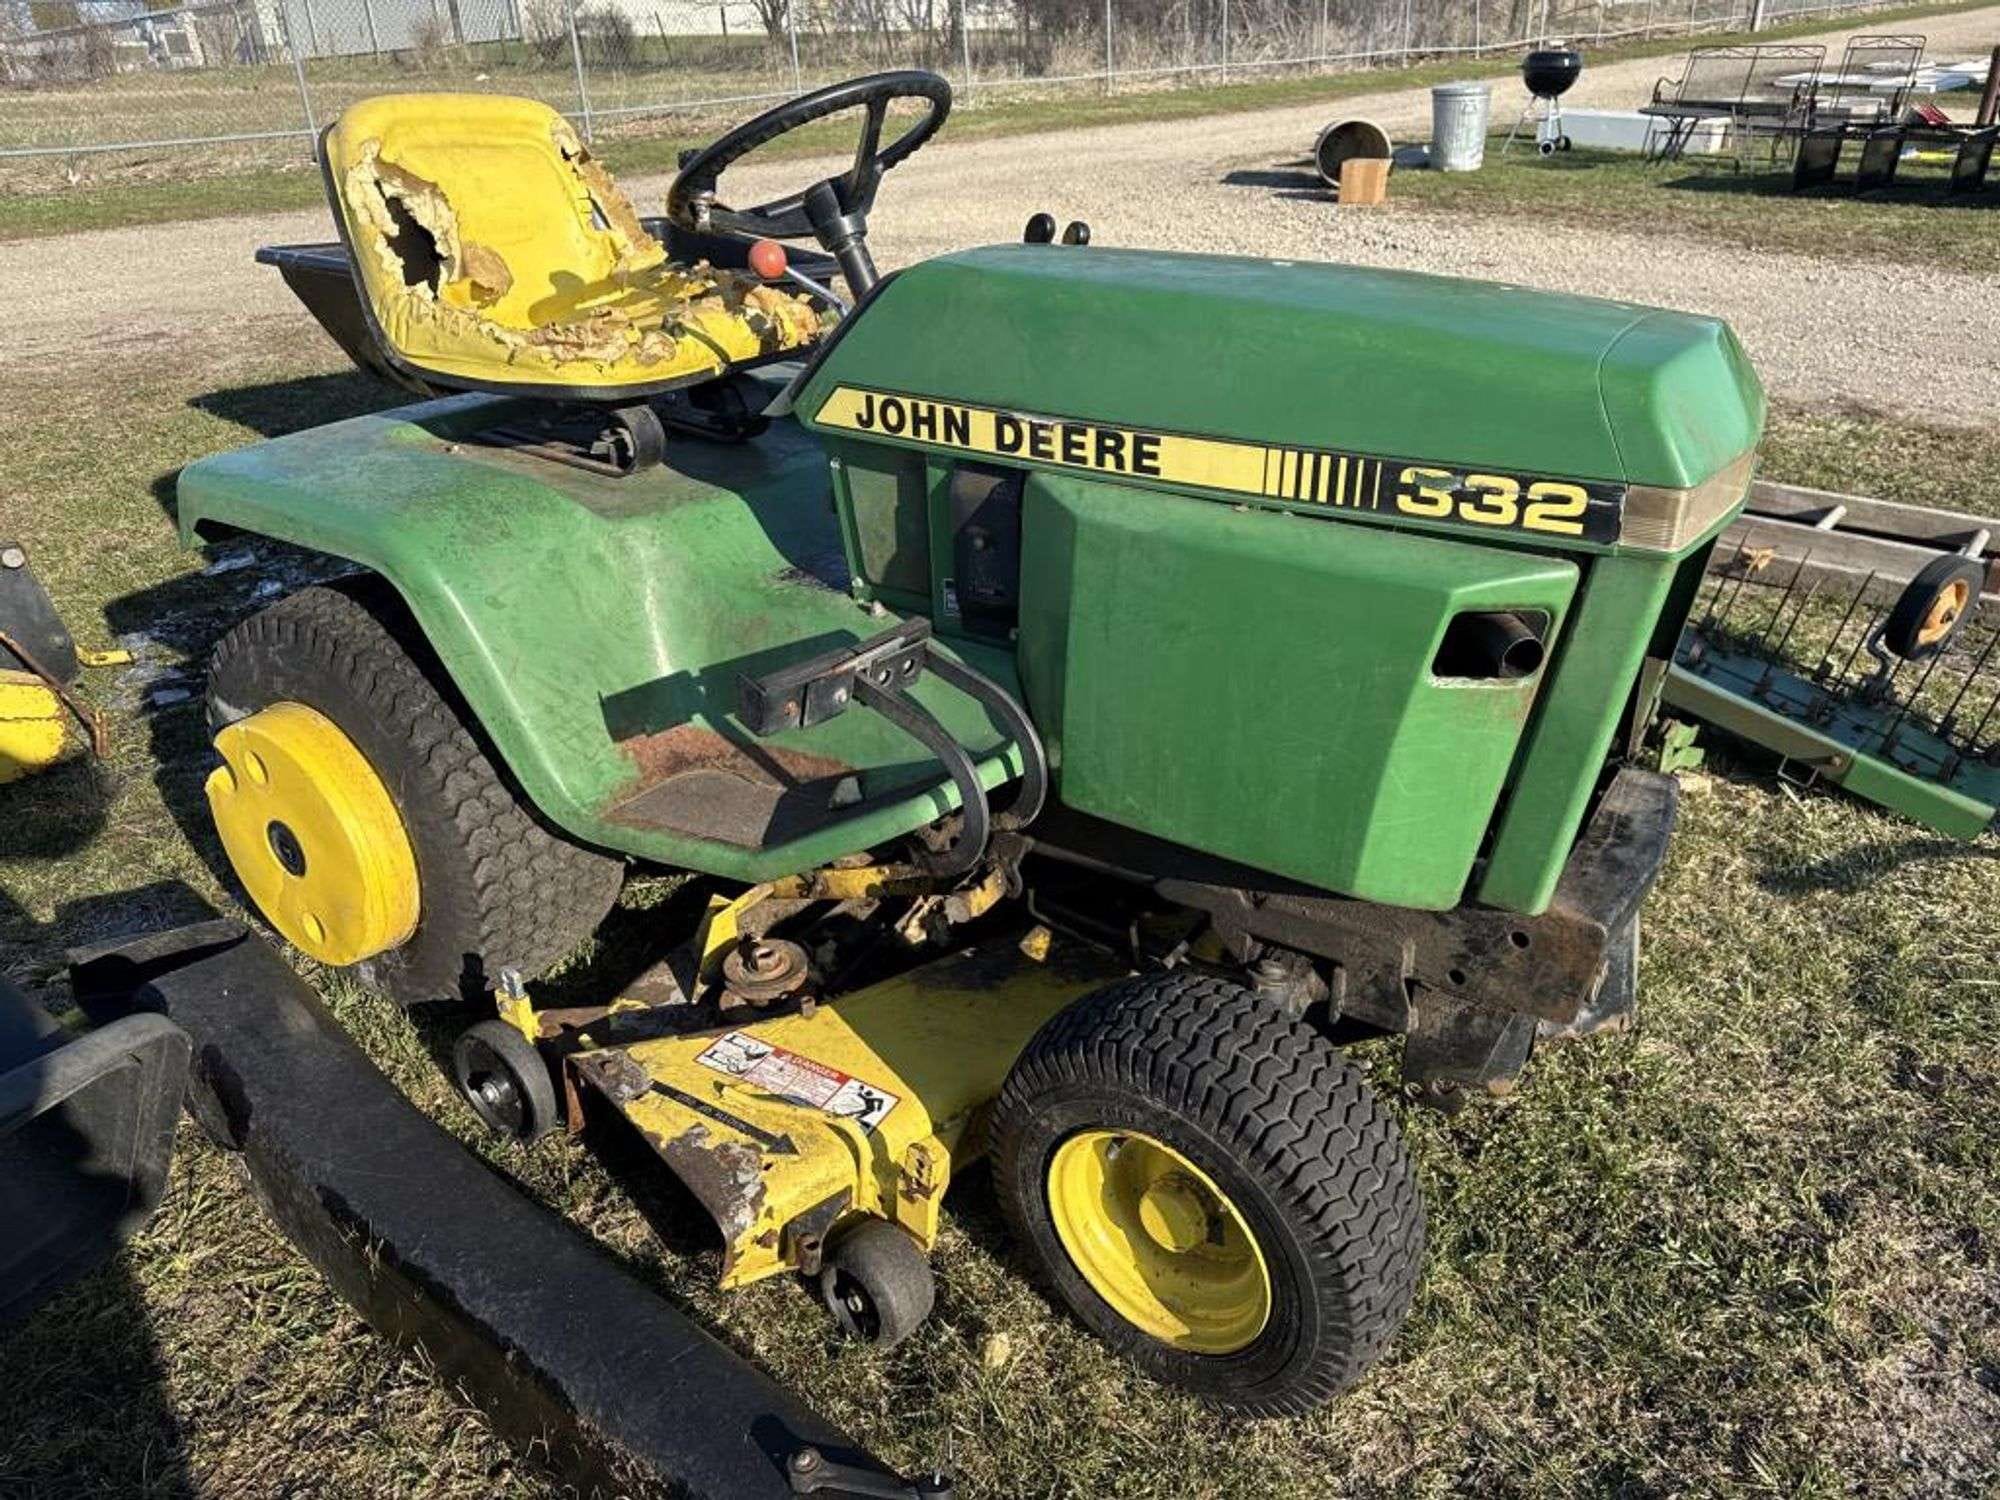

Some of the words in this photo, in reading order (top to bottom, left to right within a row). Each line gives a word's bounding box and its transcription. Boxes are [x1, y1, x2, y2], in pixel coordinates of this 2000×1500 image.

[855, 394, 970, 446] JOHN
[995, 414, 1162, 475] DEERE
[1396, 466, 1588, 535] 332
